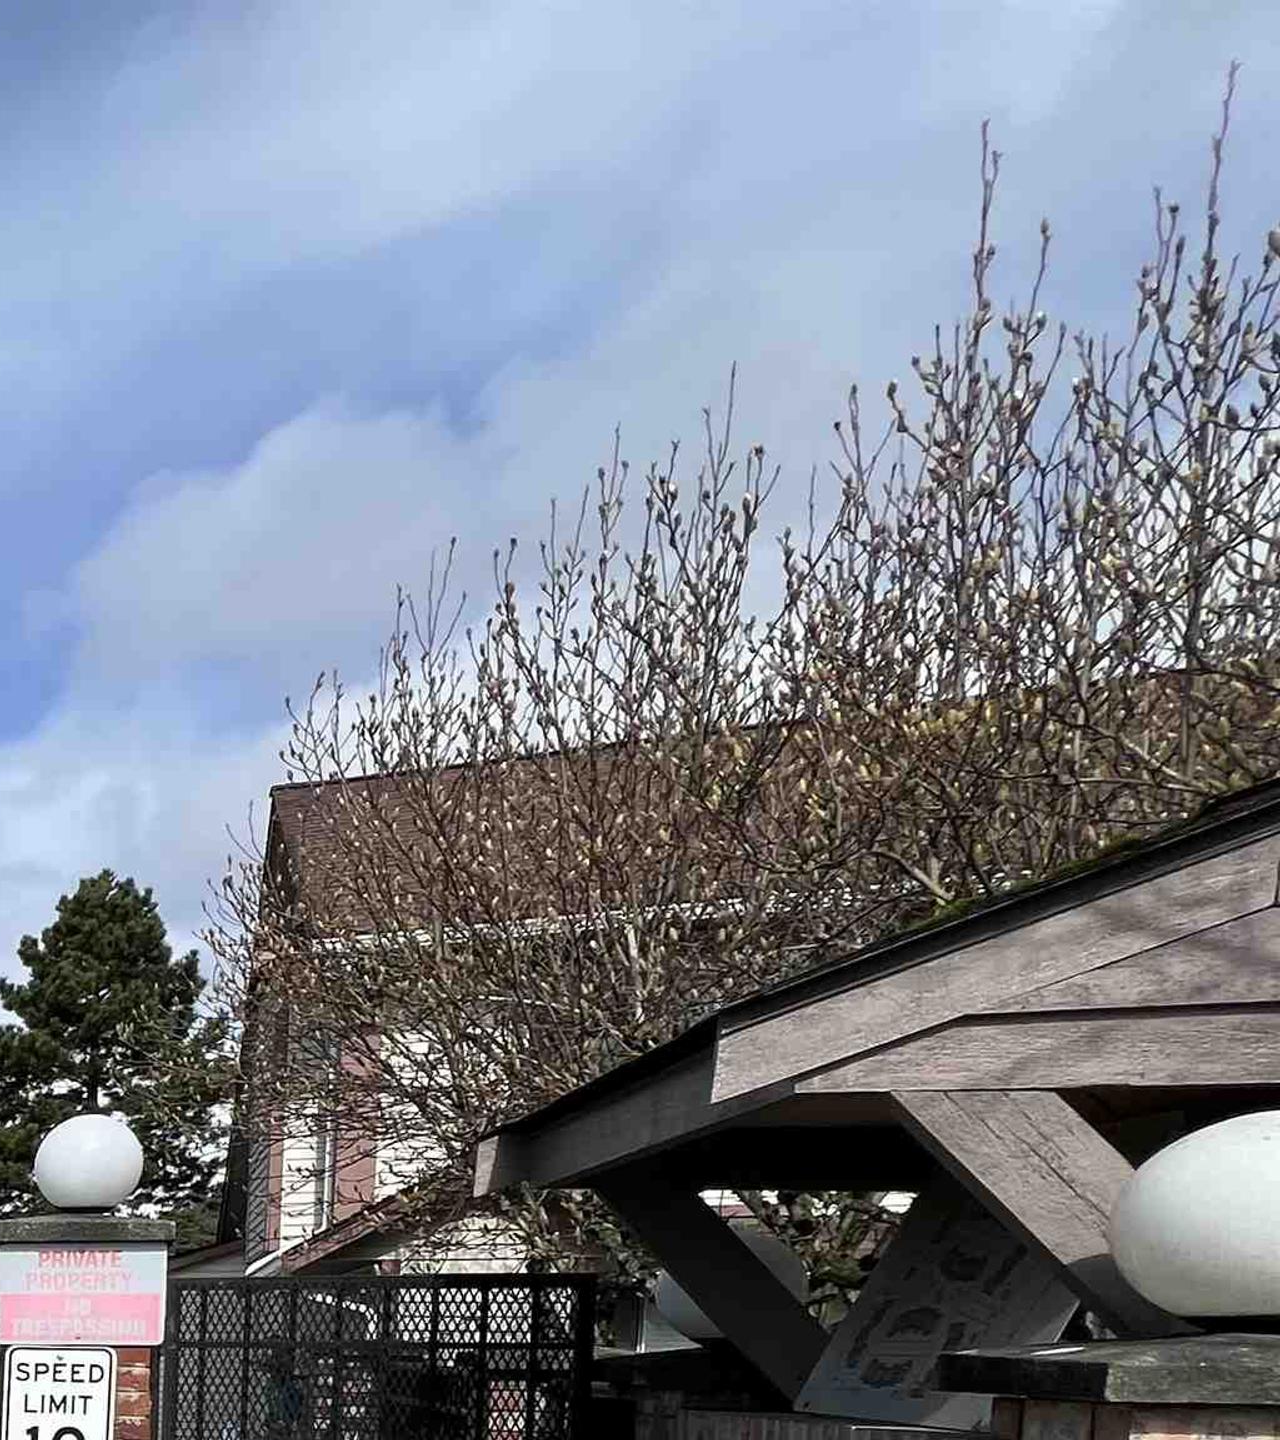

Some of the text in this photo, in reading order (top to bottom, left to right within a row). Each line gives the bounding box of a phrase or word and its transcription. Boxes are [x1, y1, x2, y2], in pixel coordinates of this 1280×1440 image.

[38, 1250, 122, 1268] PRIVATE
[24, 1271, 133, 1291] PROPERTY
[16, 1362, 104, 1383] SPEED
[24, 1393, 93, 1415] LIMIT
